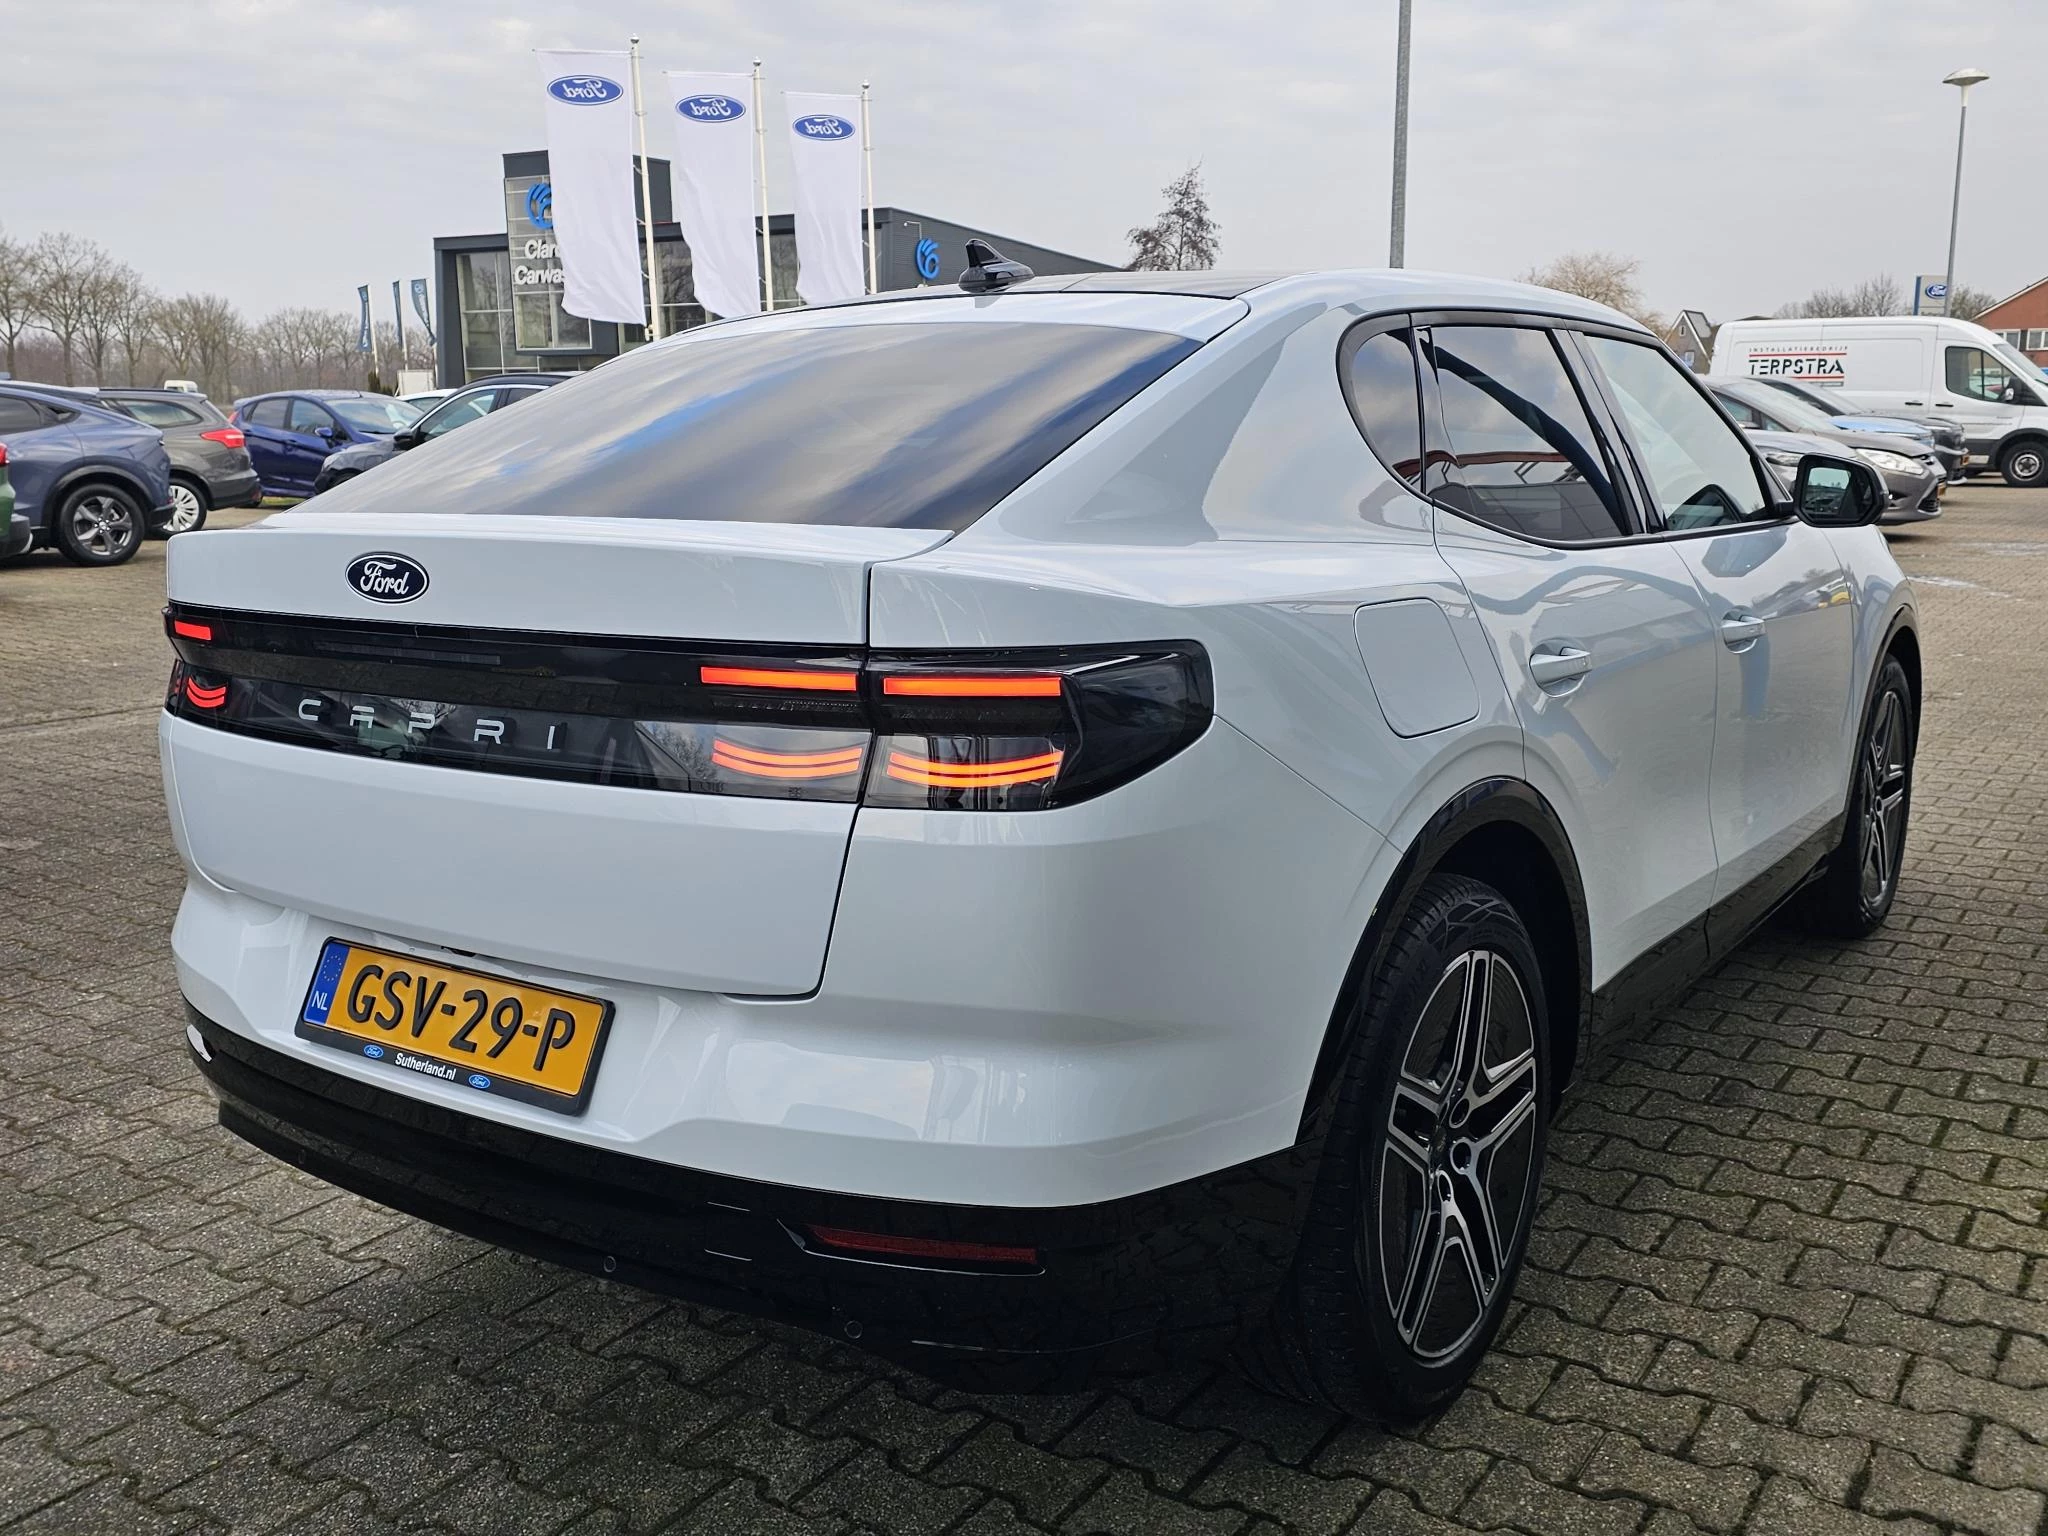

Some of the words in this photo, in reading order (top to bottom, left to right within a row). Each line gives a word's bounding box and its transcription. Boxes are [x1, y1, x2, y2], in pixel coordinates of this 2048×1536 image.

[1749, 359, 1845, 375] TERPSTRA
[360, 561, 410, 595] Ford
[298, 698, 556, 750] CAPRI
[311, 990, 328, 1011] NL
[347, 964, 576, 1072] GSV-29-P
[395, 1052, 457, 1081] Sutherland.nl
